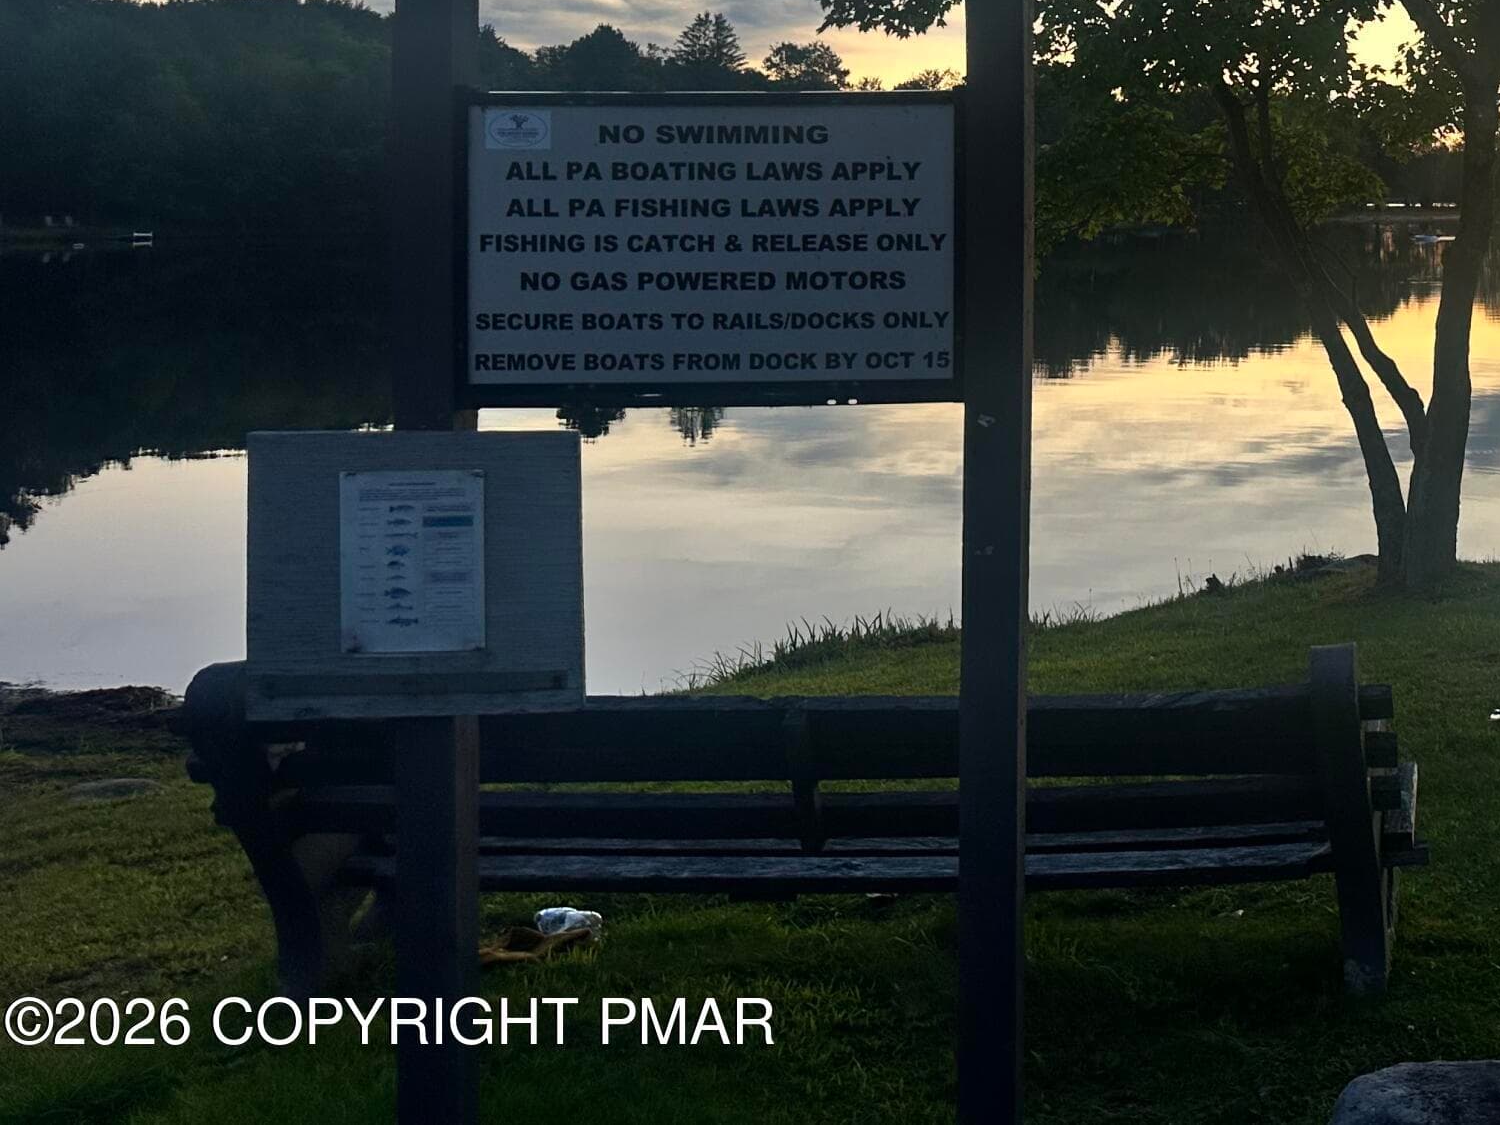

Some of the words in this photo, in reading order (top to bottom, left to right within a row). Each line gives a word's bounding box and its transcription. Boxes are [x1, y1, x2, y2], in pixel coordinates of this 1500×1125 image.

[600, 125, 644, 143] NO
[656, 125, 828, 144] SWIMMING
[506, 162, 557, 180] ALL
[567, 162, 602, 180] PA
[612, 162, 736, 181] BOATING
[747, 162, 822, 181] LAWS
[832, 162, 921, 180] APPLY
[506, 199, 559, 217] ALL
[569, 199, 605, 217] PA
[615, 199, 730, 217] FISHING
[741, 199, 819, 217] LAWS
[829, 198, 920, 216] APPLY
[480, 235, 584, 252] FISHING
[595, 235, 618, 252] IS
[627, 235, 714, 252] CATCH
[725, 235, 742, 252] &
[753, 234, 868, 252] RELEASE
[877, 234, 947, 251] ONLY
[521, 272, 560, 291] NO
[571, 272, 627, 291] GAS
[638, 272, 775, 291] POWERED
[786, 271, 905, 290] MOTORS
[476, 314, 573, 330] SECURE
[582, 313, 663, 330] BOATS
[671, 313, 704, 330] TO
[713, 312, 875, 330] RAILS/DOCKS
[883, 312, 949, 328] ONLY
[475, 354, 575, 371] REMOVE
[584, 354, 664, 370] BOATS
[673, 354, 740, 370] FROM
[750, 353, 817, 370] DOCK
[825, 353, 858, 369] BY
[866, 352, 915, 369] OCT
[923, 351, 950, 368] 15
